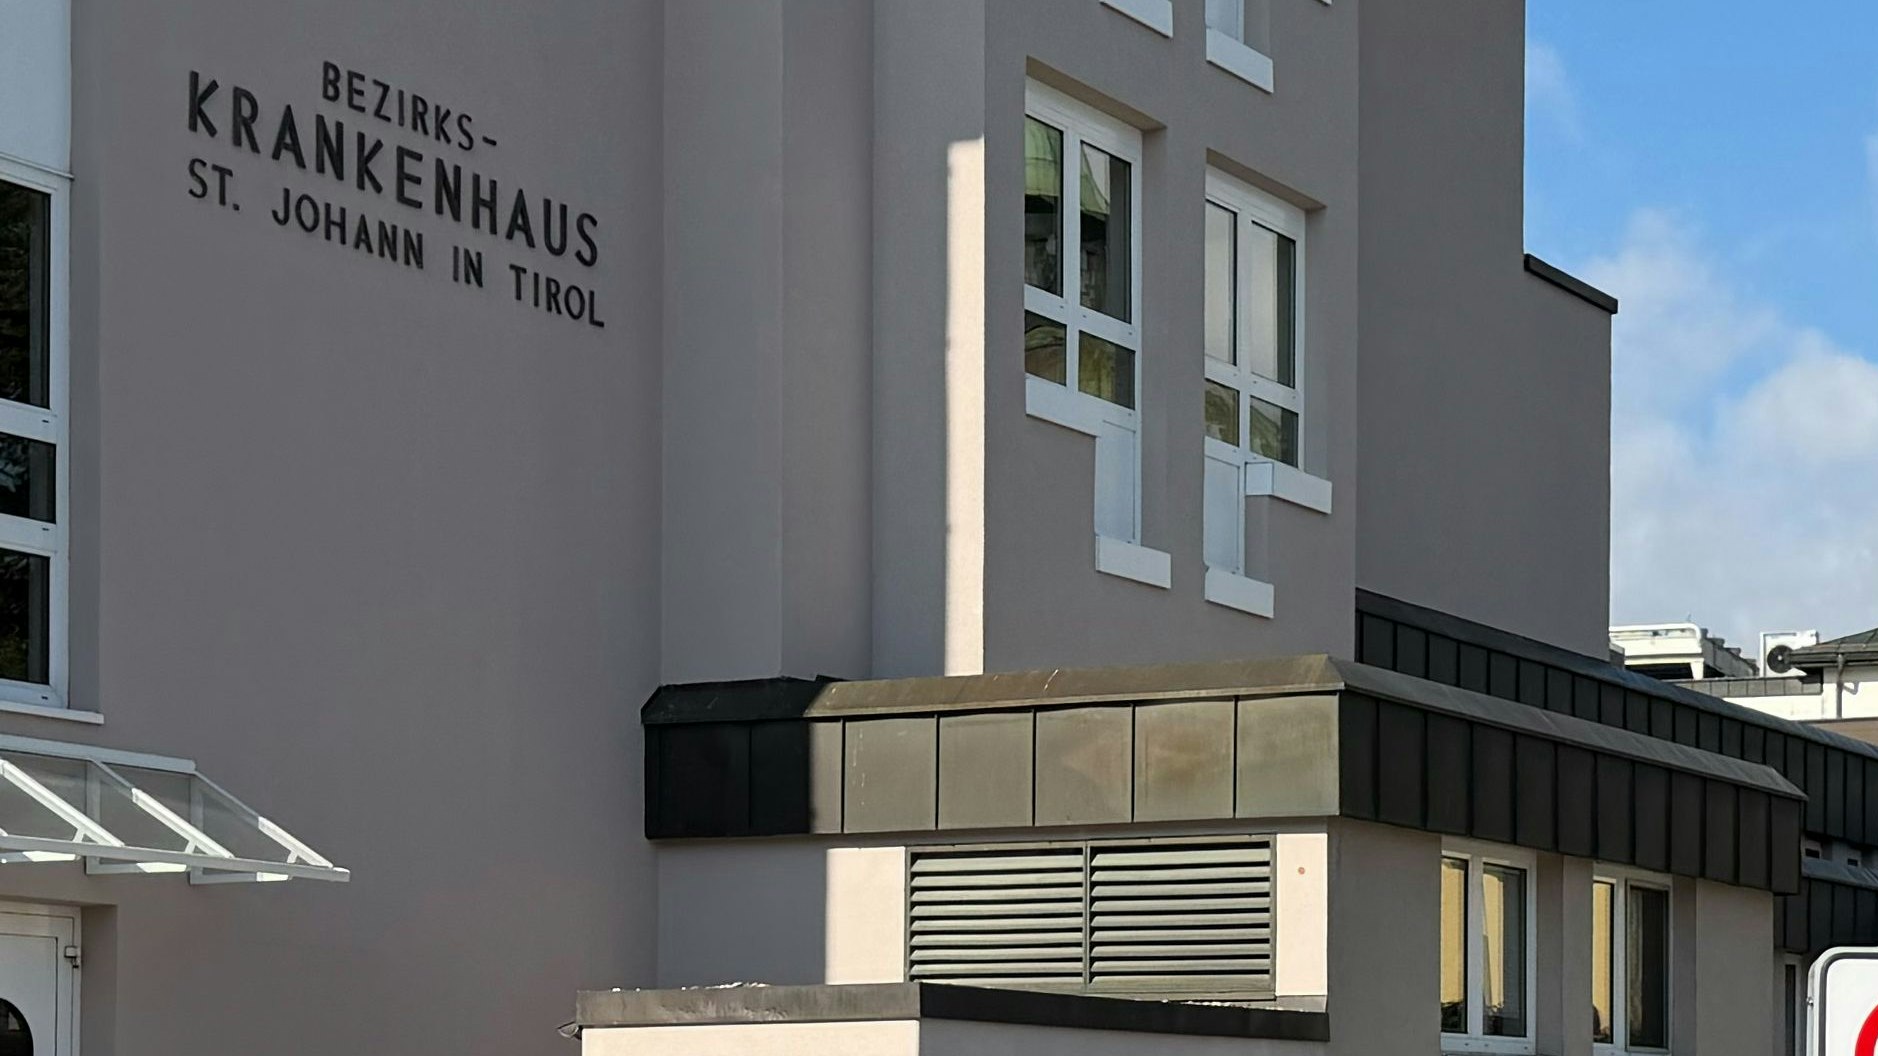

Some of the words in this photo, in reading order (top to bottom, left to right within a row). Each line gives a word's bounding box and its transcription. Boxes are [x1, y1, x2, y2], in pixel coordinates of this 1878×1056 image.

[187, 70, 598, 267] KRANKENHAUS
[322, 60, 497, 151] BEZIRKS-
[188, 158, 240, 211] ST.
[271, 188, 424, 269] JOHANN
[453, 245, 484, 288] IN
[509, 264, 605, 328] TIROL
